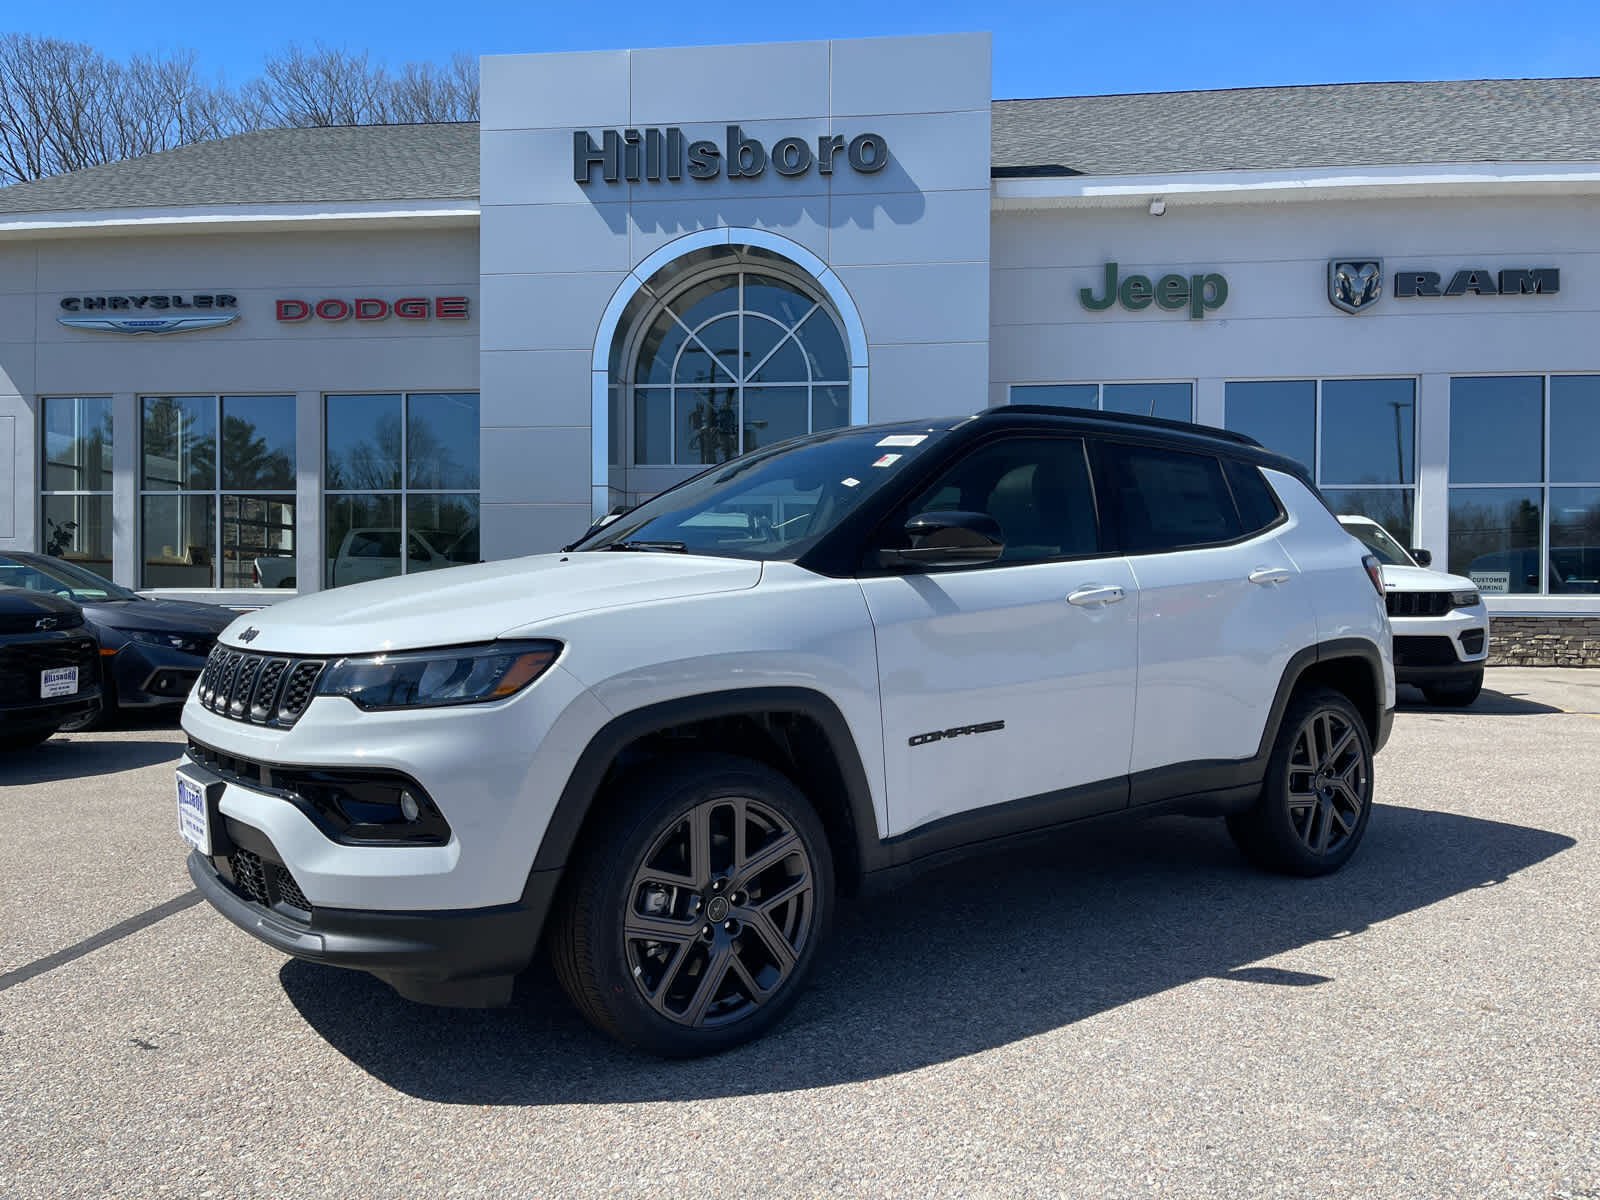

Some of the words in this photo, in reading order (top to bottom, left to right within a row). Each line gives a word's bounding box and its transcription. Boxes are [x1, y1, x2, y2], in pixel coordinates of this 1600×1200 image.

[573, 125, 889, 183] Hillsboro
[1080, 262, 1229, 319] Jeep
[1394, 268, 1560, 297] RAM
[60, 294, 238, 311] CHRYSLER
[276, 296, 470, 321] DODGE
[908, 719, 1005, 746] COMPASS
